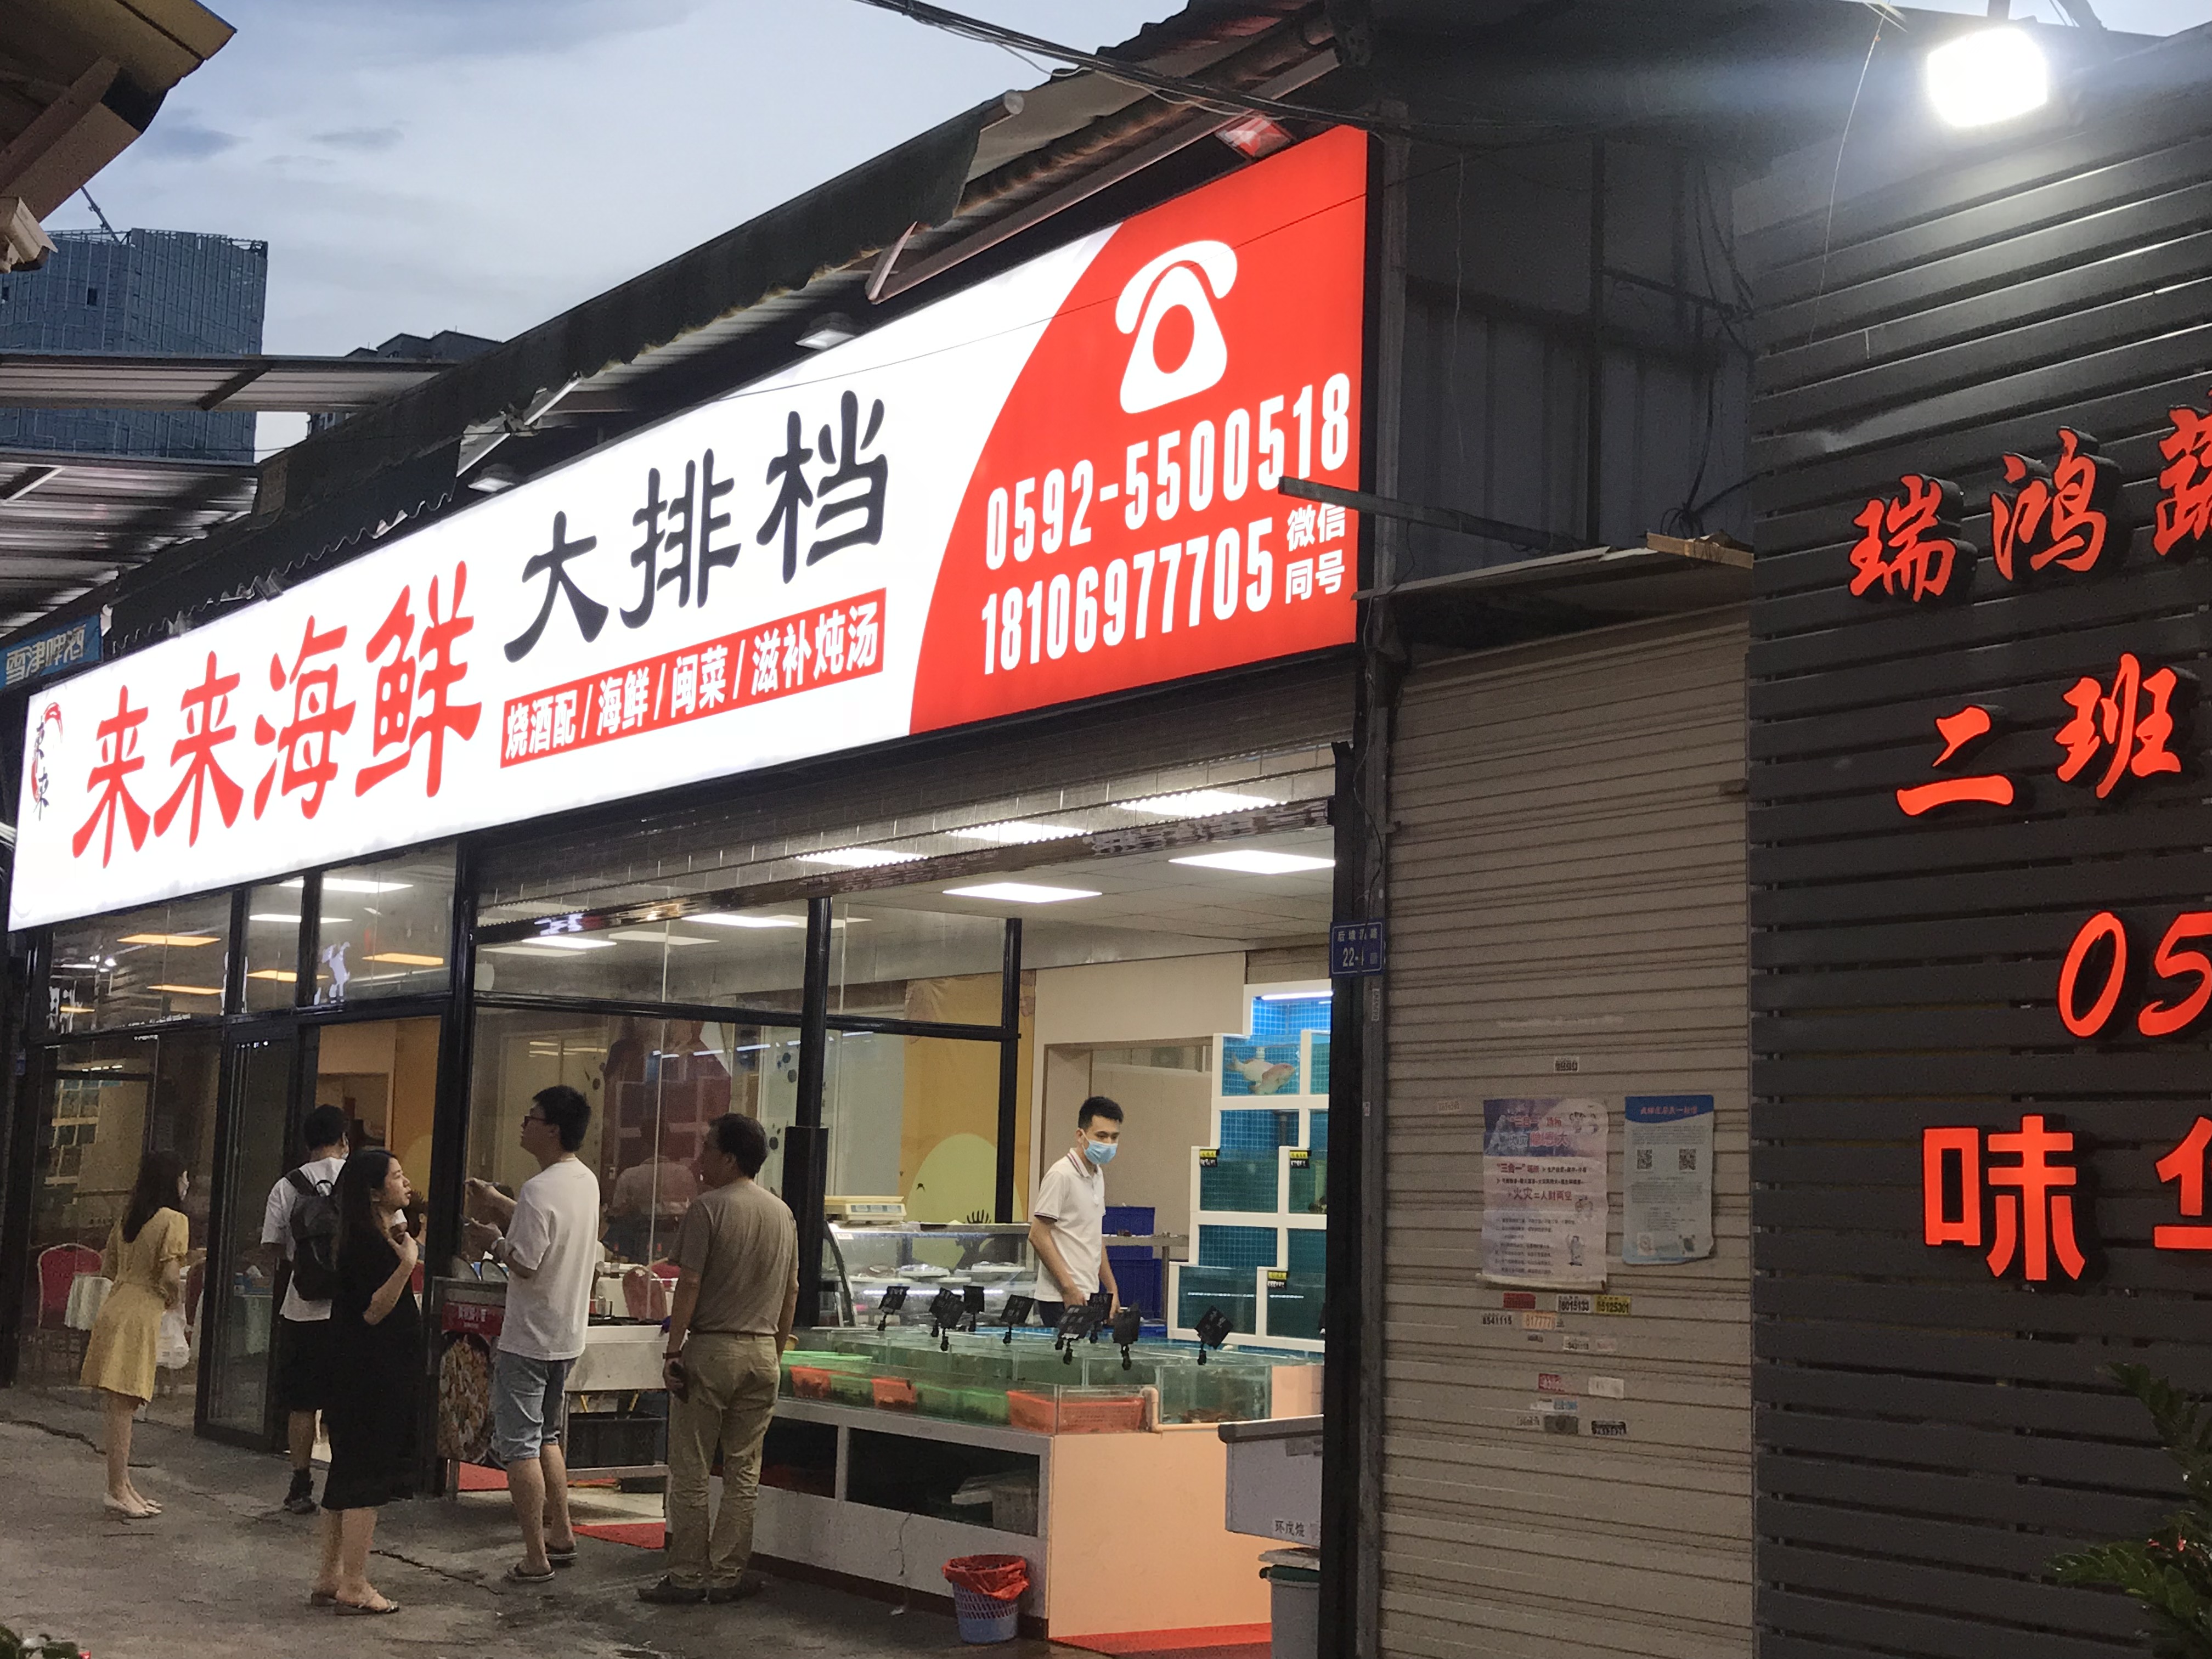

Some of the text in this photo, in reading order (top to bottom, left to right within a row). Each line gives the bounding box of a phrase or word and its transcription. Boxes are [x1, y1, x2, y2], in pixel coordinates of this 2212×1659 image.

[986, 373, 1350, 571] 0592-5500518
[1286, 503, 1346, 552] 微信
[72, 390, 889, 868] 来来海鲜 大排档
[982, 517, 1273, 674] 18106977705
[1285, 549, 1345, 604] 同号
[1897, 653, 2181, 816] 二班
[2057, 911, 2212, 1037] 05
